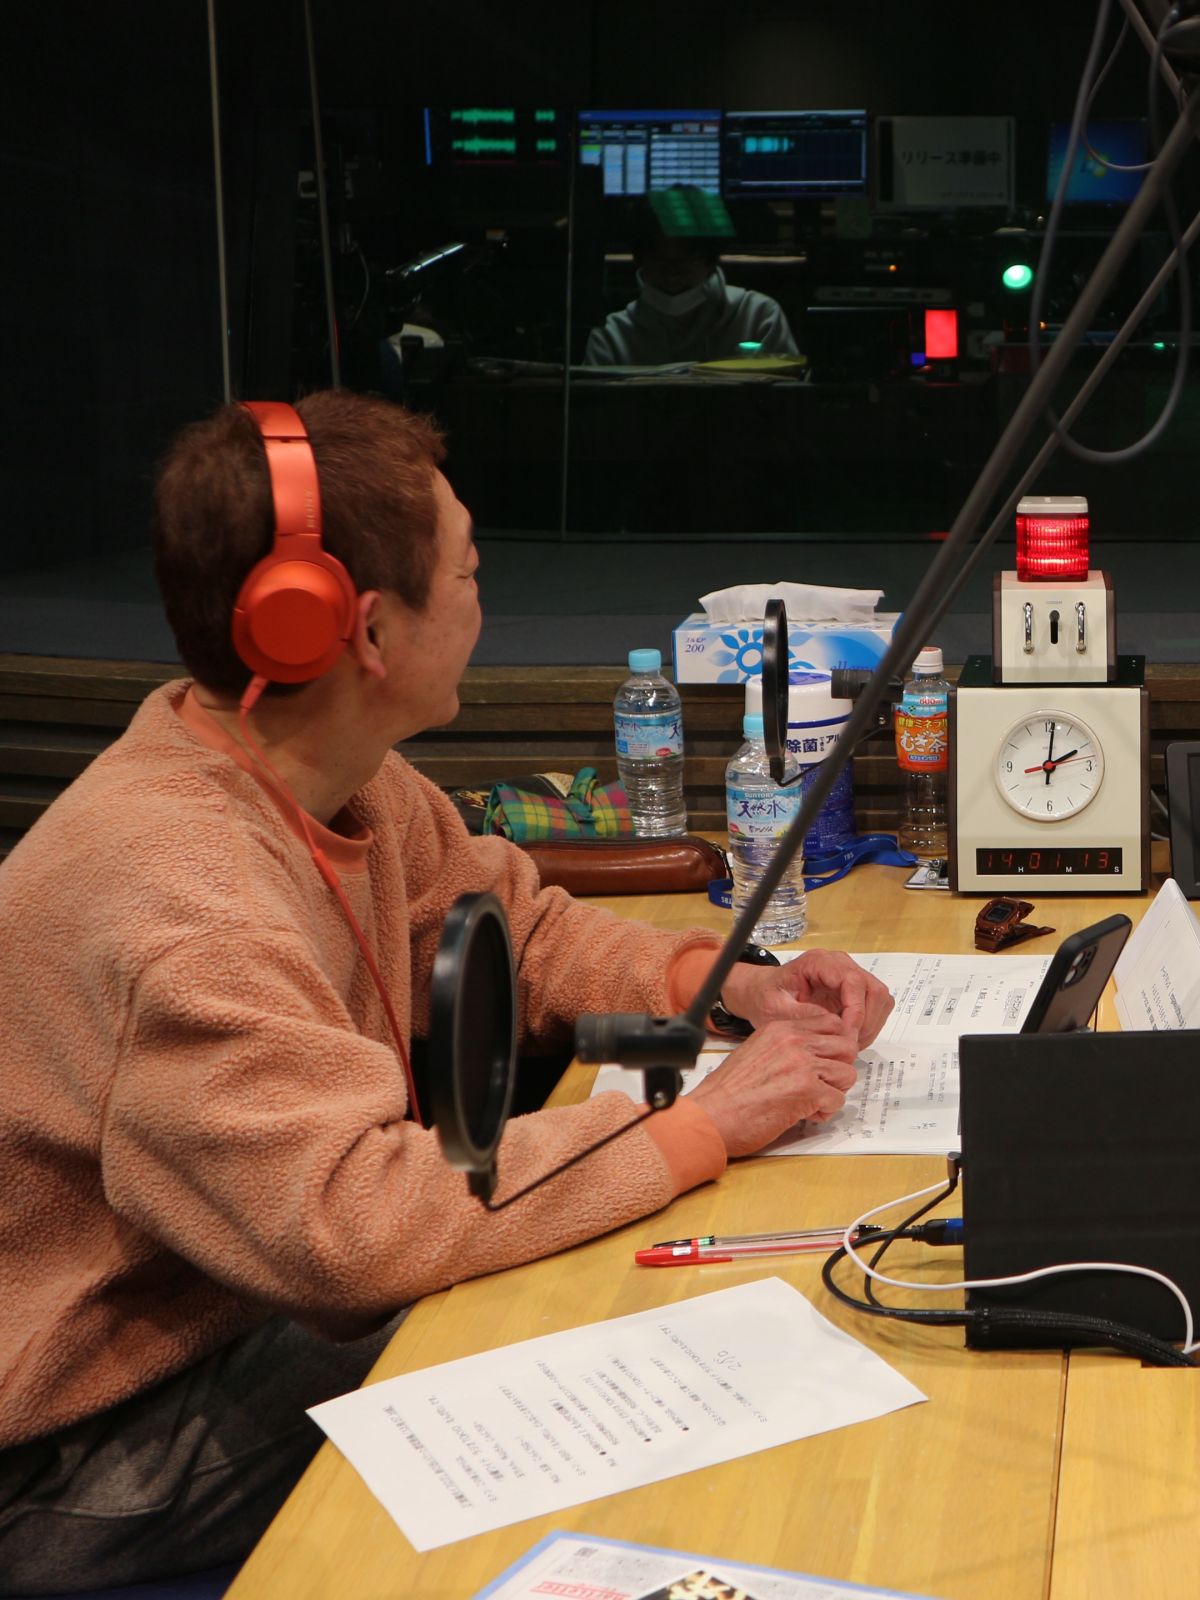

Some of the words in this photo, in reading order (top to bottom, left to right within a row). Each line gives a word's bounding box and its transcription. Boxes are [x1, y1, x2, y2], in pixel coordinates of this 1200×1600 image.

[902, 150, 1002, 166] リリース準備中
[685, 643, 705, 653] 200
[786, 738, 818, 753] 除菌
[900, 730, 947, 752] むぎ茶
[1006, 761, 1013, 773] 9
[1086, 760, 1093, 772] 3
[737, 800, 787, 819] 天然水
[1046, 800, 1053, 812] 6
